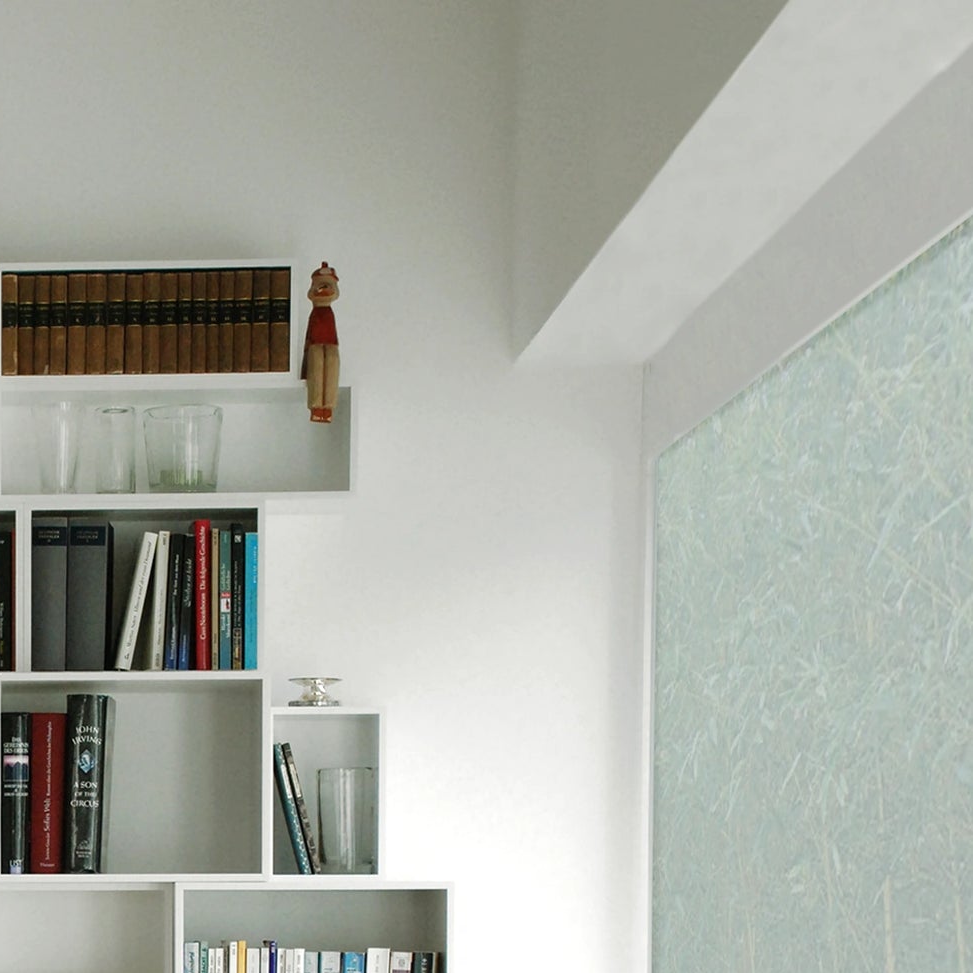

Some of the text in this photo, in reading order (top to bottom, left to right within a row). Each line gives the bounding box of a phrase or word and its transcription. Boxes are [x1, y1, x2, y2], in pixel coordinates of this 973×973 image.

[75, 726, 99, 735] JOHN
[72, 735, 102, 746] IRVING
[70, 800, 99, 808] CIRCUS
